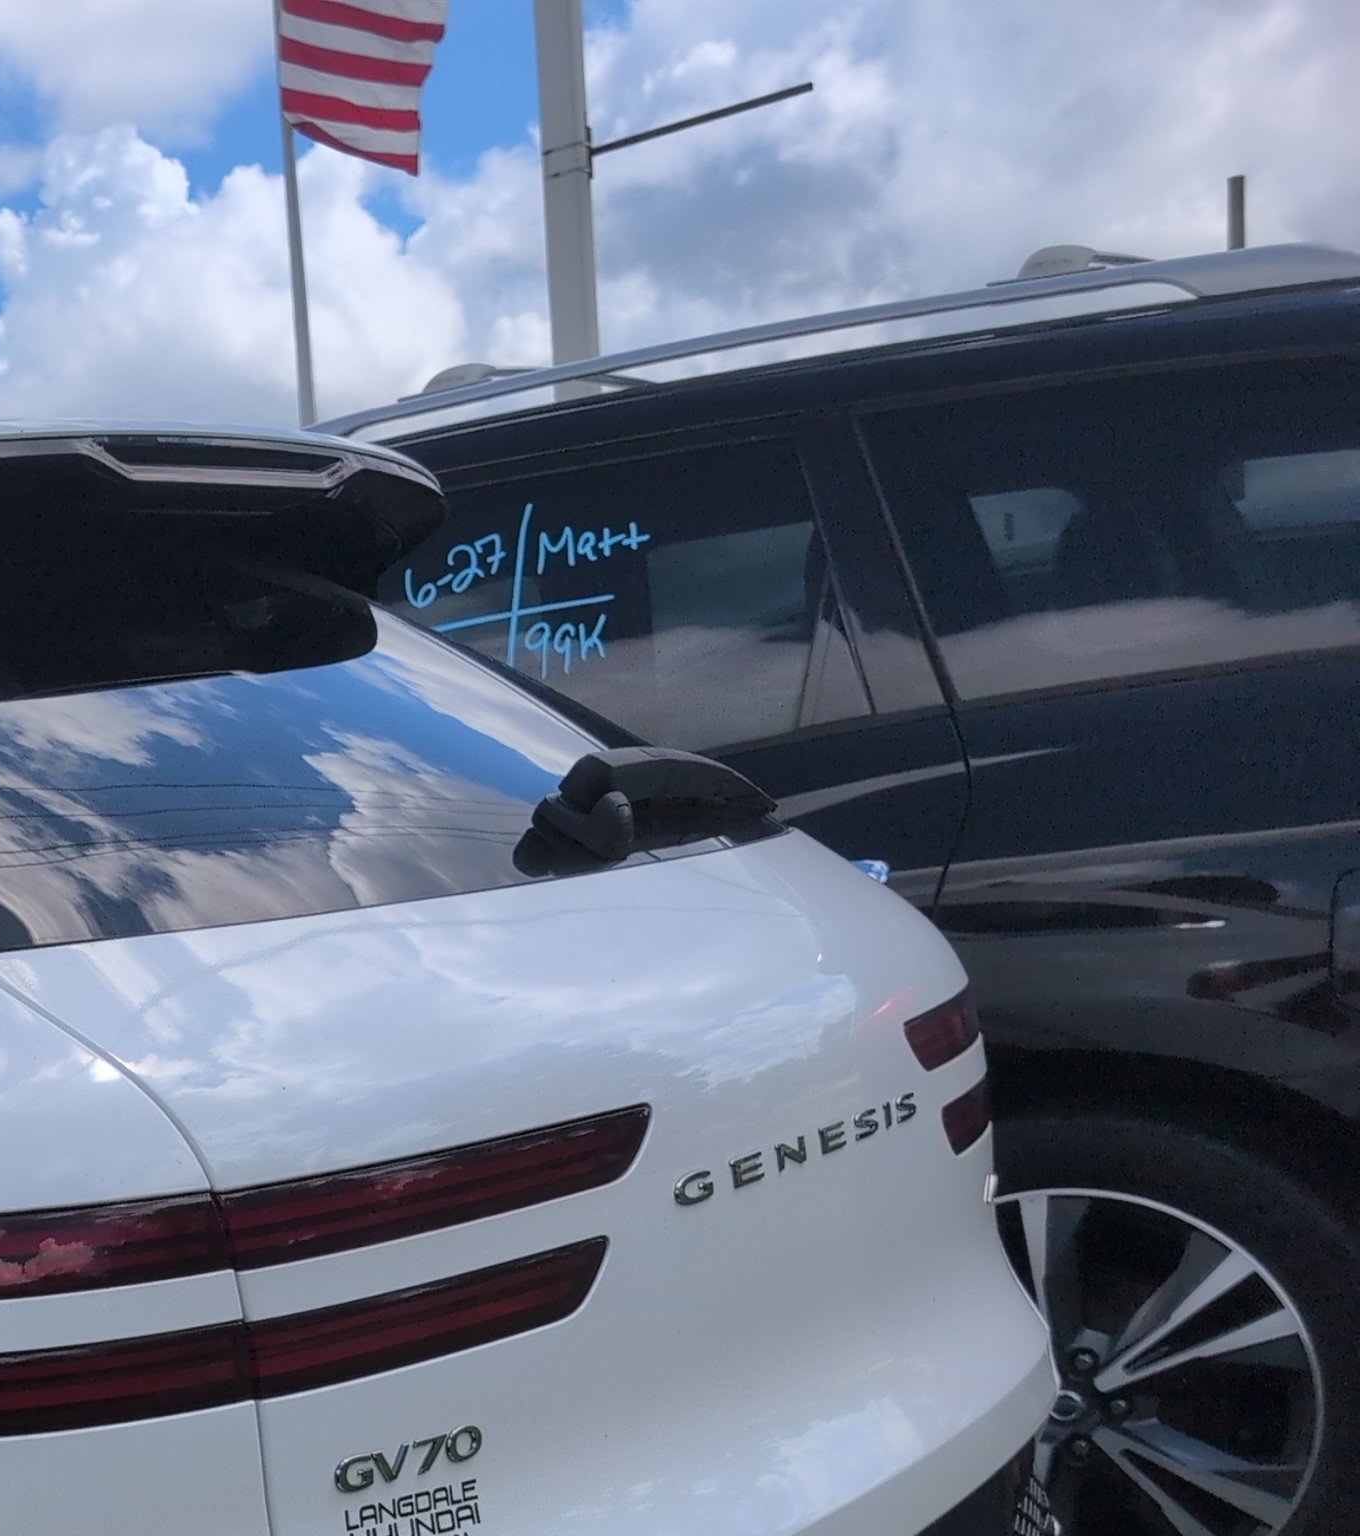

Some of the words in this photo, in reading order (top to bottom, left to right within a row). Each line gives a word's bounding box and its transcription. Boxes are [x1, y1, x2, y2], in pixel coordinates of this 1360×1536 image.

[405, 532, 507, 609] 6-27
[536, 521, 651, 576] Matt
[524, 613, 608, 680] 99K
[673, 1092, 917, 1206] GENESIS
[334, 1424, 483, 1494] GV70
[344, 1478, 479, 1532] LANGDALE
